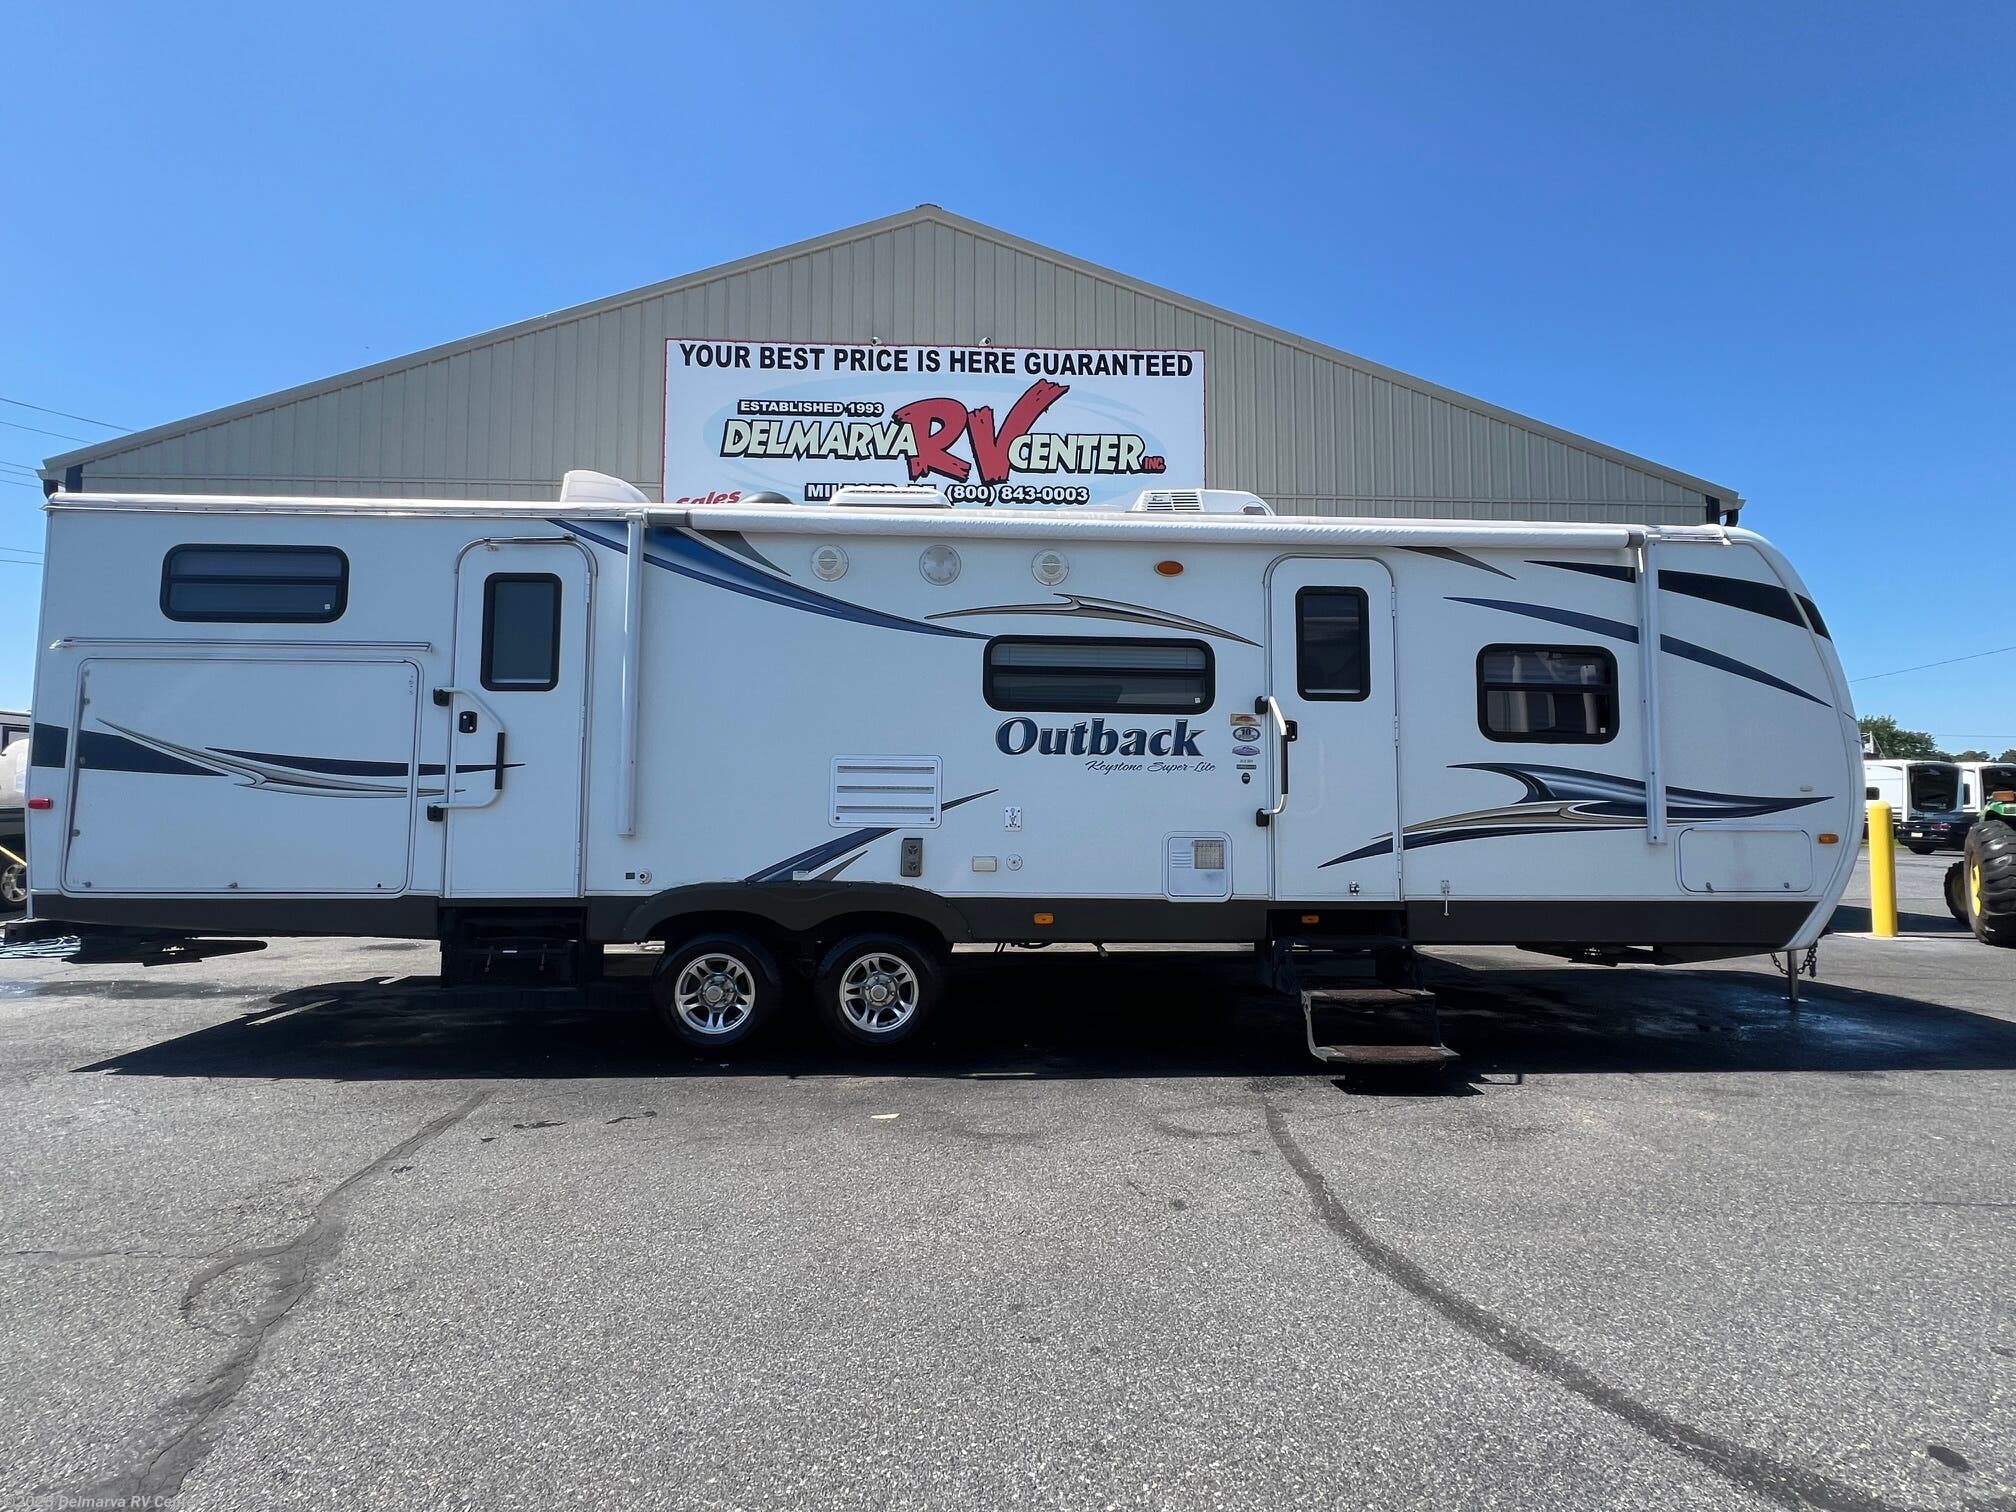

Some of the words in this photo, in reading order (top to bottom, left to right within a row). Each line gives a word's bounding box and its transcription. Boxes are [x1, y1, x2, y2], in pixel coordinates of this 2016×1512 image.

[680, 343, 751, 369] YOUR
[759, 346, 826, 371] BEST
[834, 348, 909, 372] PRICE
[917, 349, 942, 373] IS
[949, 350, 1016, 374] HERE
[1024, 352, 1193, 377] GUARANTEED
[739, 400, 844, 416] ESTABLISHED
[847, 402, 884, 416] 1993
[721, 418, 919, 459] DELMARVA
[892, 379, 1071, 486] RV
[1008, 433, 1145, 474] CENTER
[947, 484, 996, 505] (800)
[1001, 486, 1090, 505] 843-0003
[995, 717, 1207, 757] Outback
[1085, 760, 1143, 775] Keystone
[1147, 761, 1217, 775] Super-Lite
